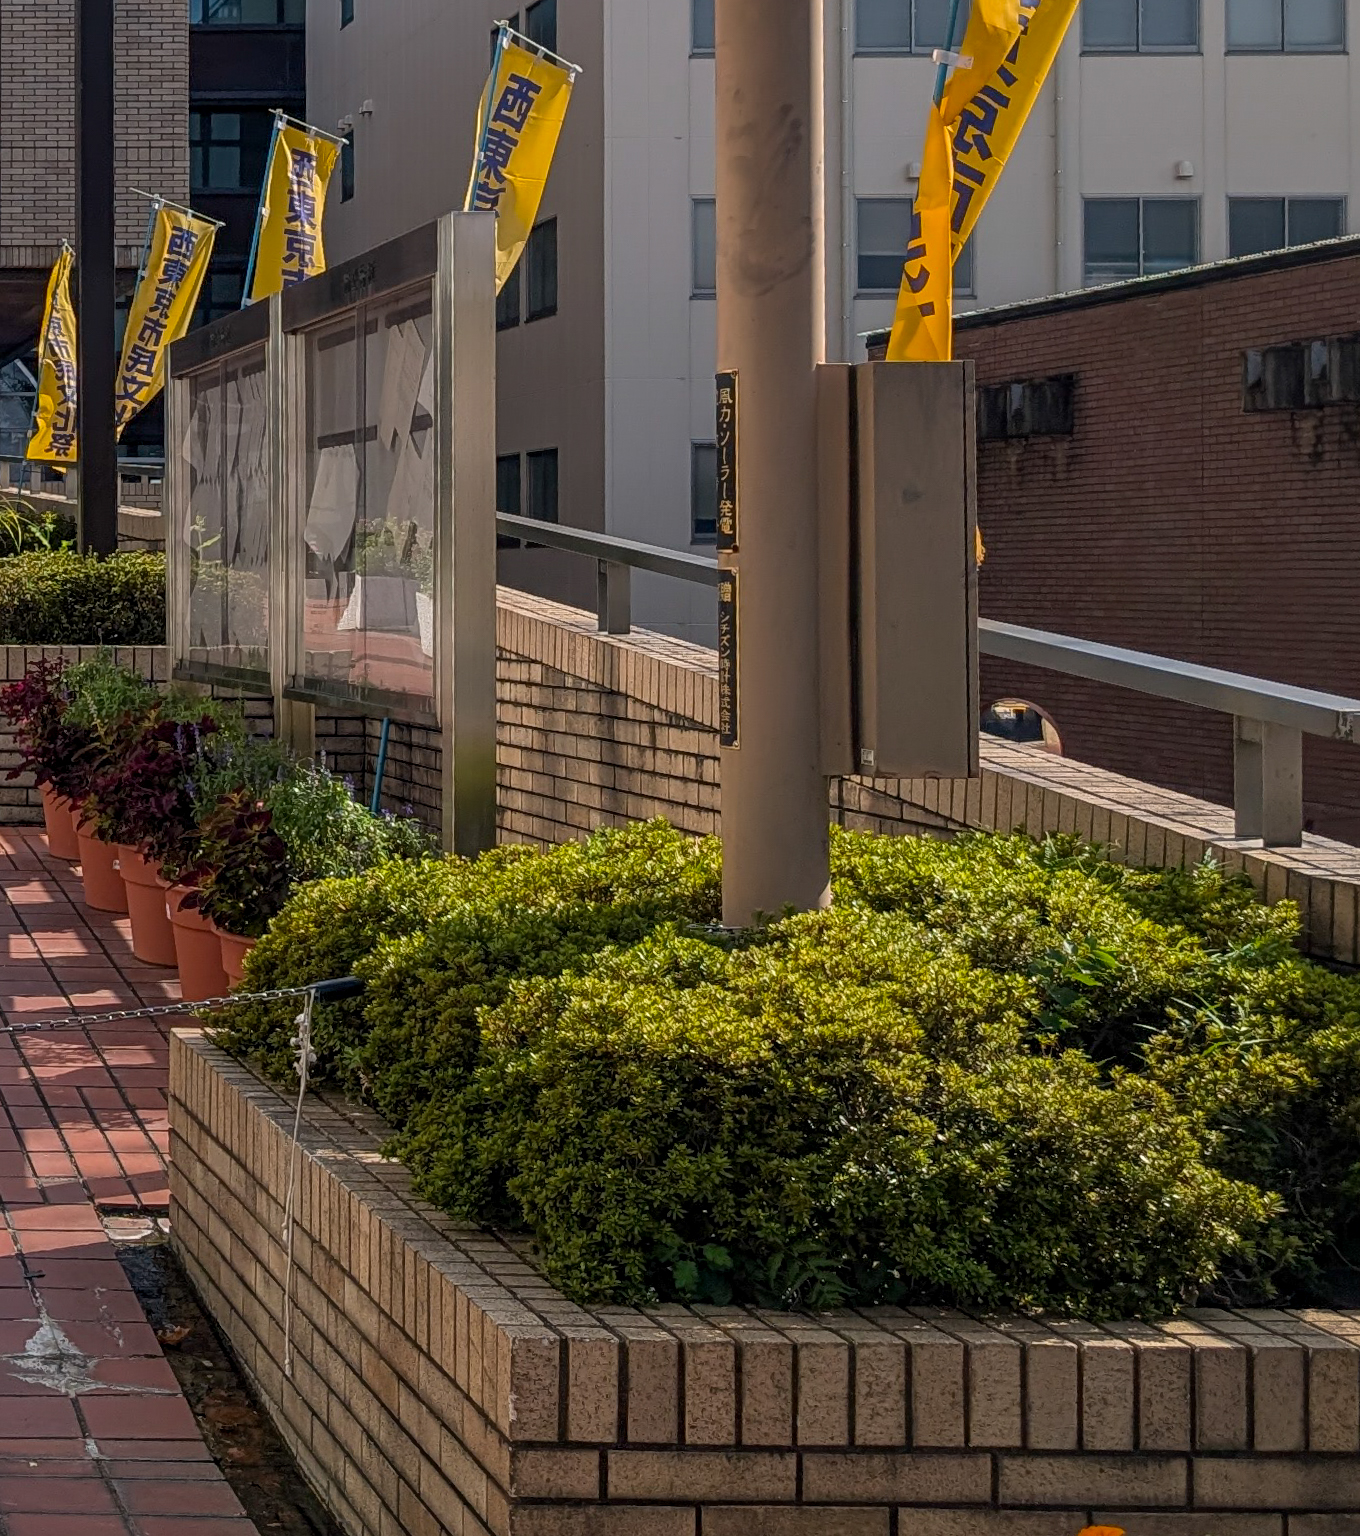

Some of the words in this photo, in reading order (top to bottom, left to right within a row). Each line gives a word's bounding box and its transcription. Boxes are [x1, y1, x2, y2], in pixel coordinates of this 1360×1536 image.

[718, 387, 733, 535] 風力・ソーラー発電
[720, 611, 732, 735] シチズン時計株式会社
